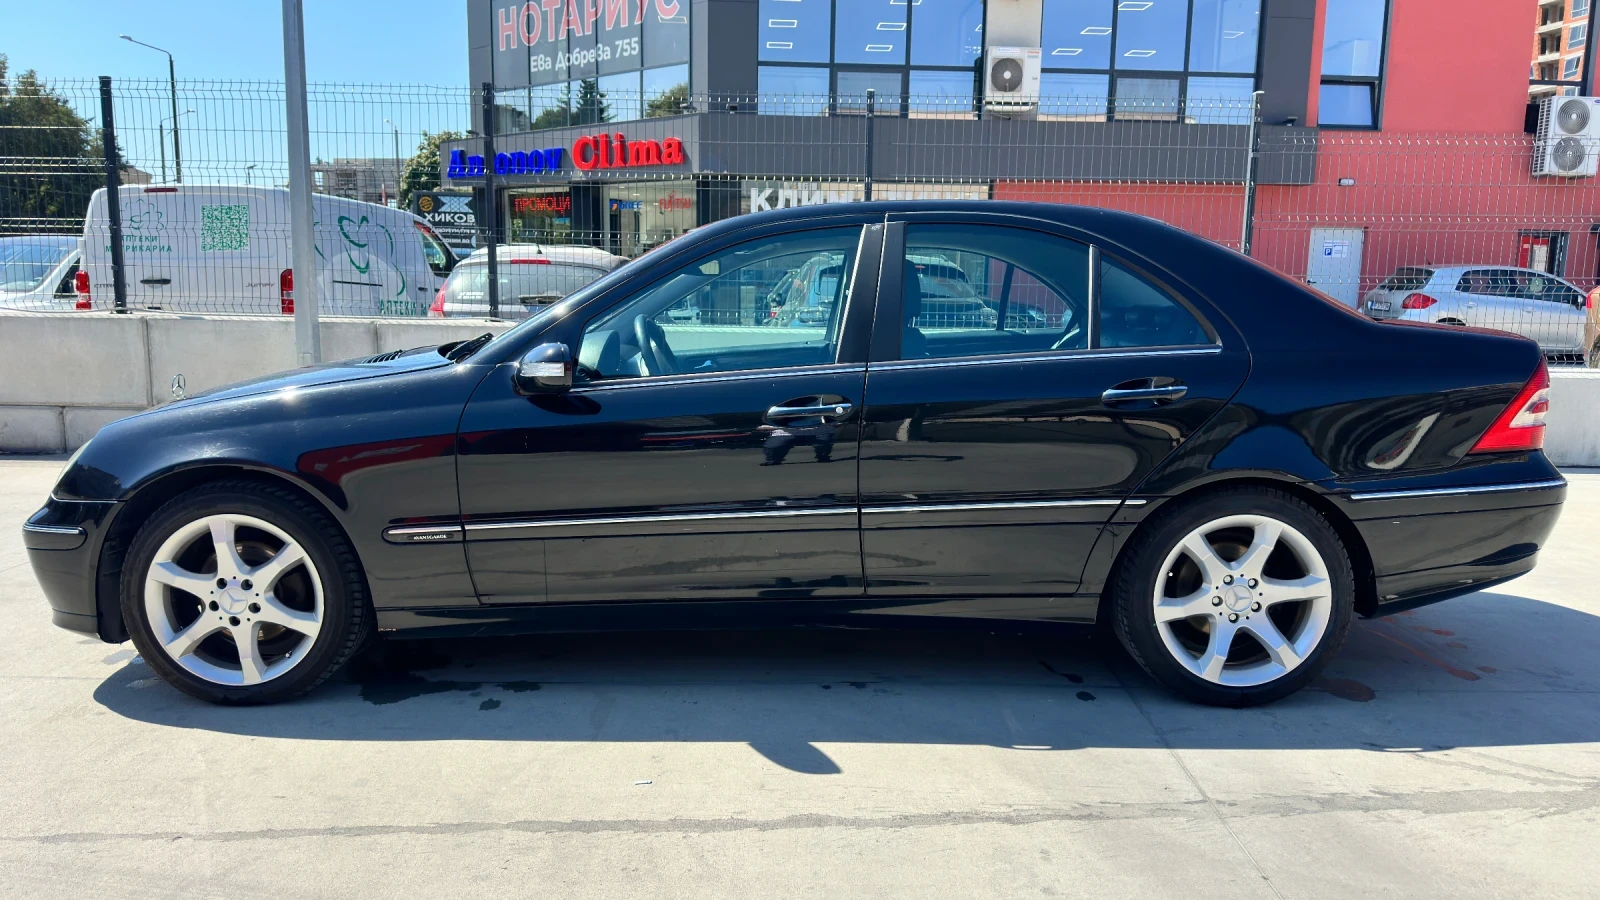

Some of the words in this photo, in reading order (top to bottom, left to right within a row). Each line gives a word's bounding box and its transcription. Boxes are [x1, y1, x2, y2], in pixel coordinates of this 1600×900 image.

[531, 56, 552, 72] Ева
[615, 37, 639, 58] 755
[447, 148, 565, 179] Anonov
[572, 132, 685, 171] Clima
[105, 245, 173, 253] МРИКАРИА
[121, 235, 158, 243] ПТЕКИ
